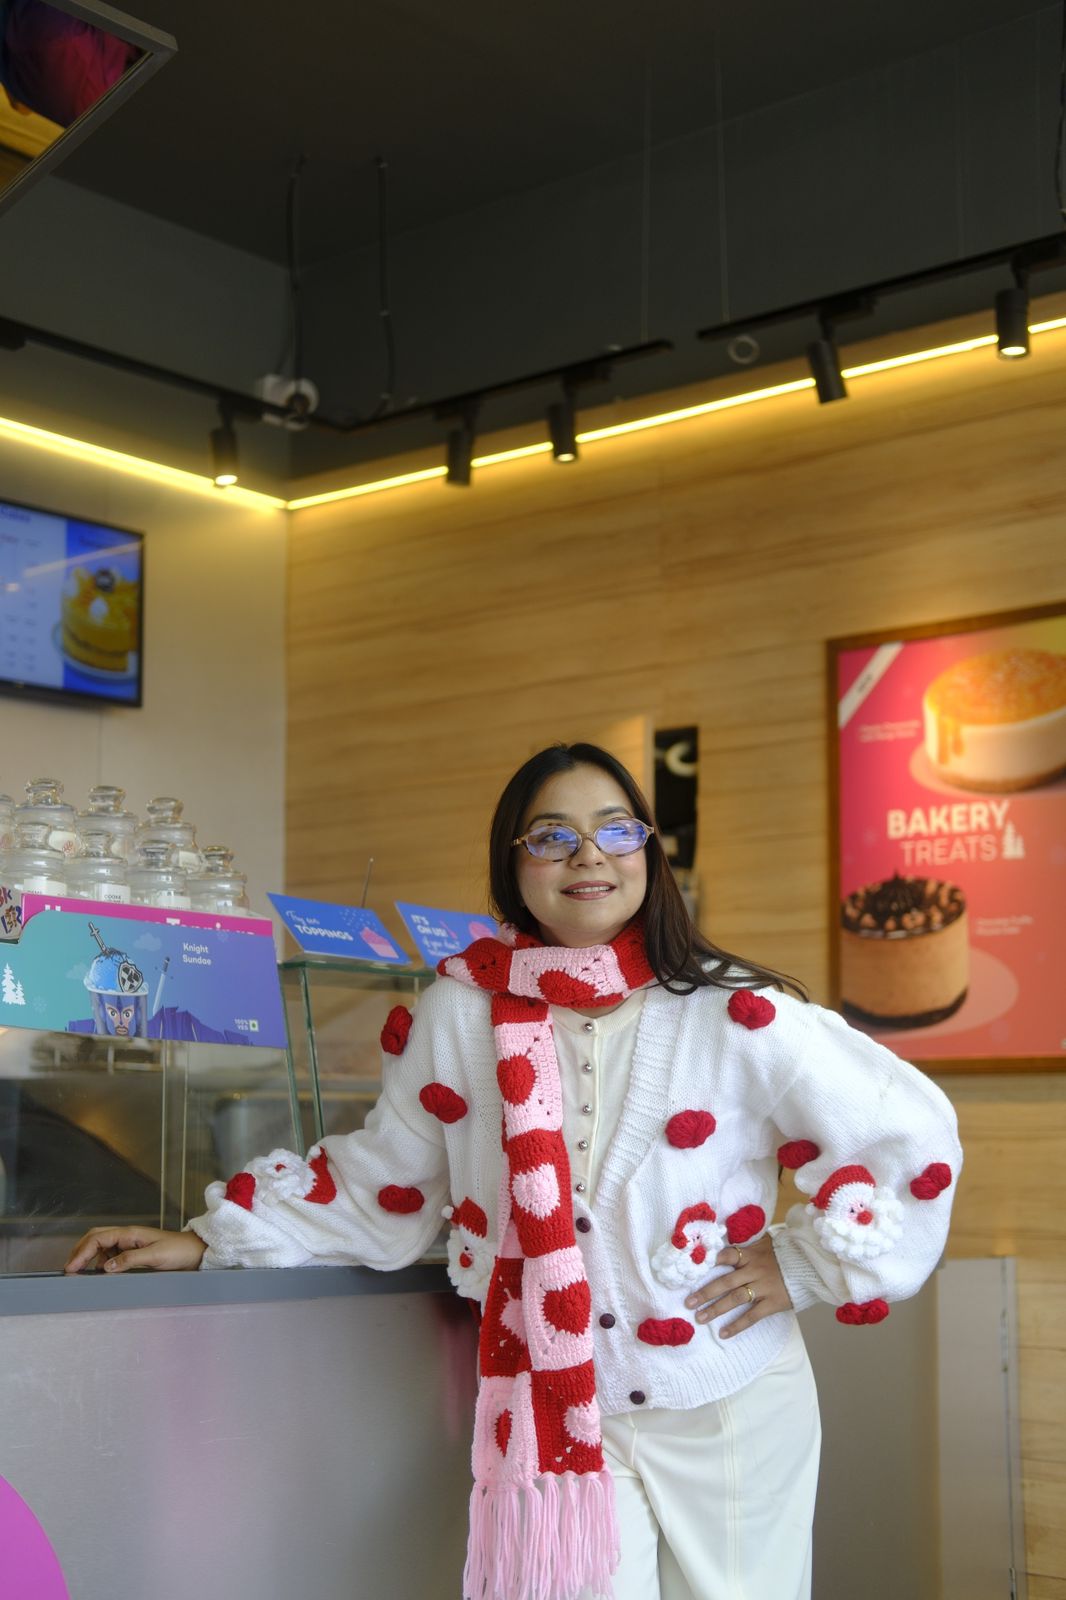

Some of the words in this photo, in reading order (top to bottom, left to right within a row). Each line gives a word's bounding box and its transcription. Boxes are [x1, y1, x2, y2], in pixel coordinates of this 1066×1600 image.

[887, 799, 1010, 839] BAKERY
[901, 834, 998, 866] TREATS
[294, 924, 354, 941] TOPPINGS
[183, 942, 209, 954] Knight
[182, 954, 212, 965] Sundae
